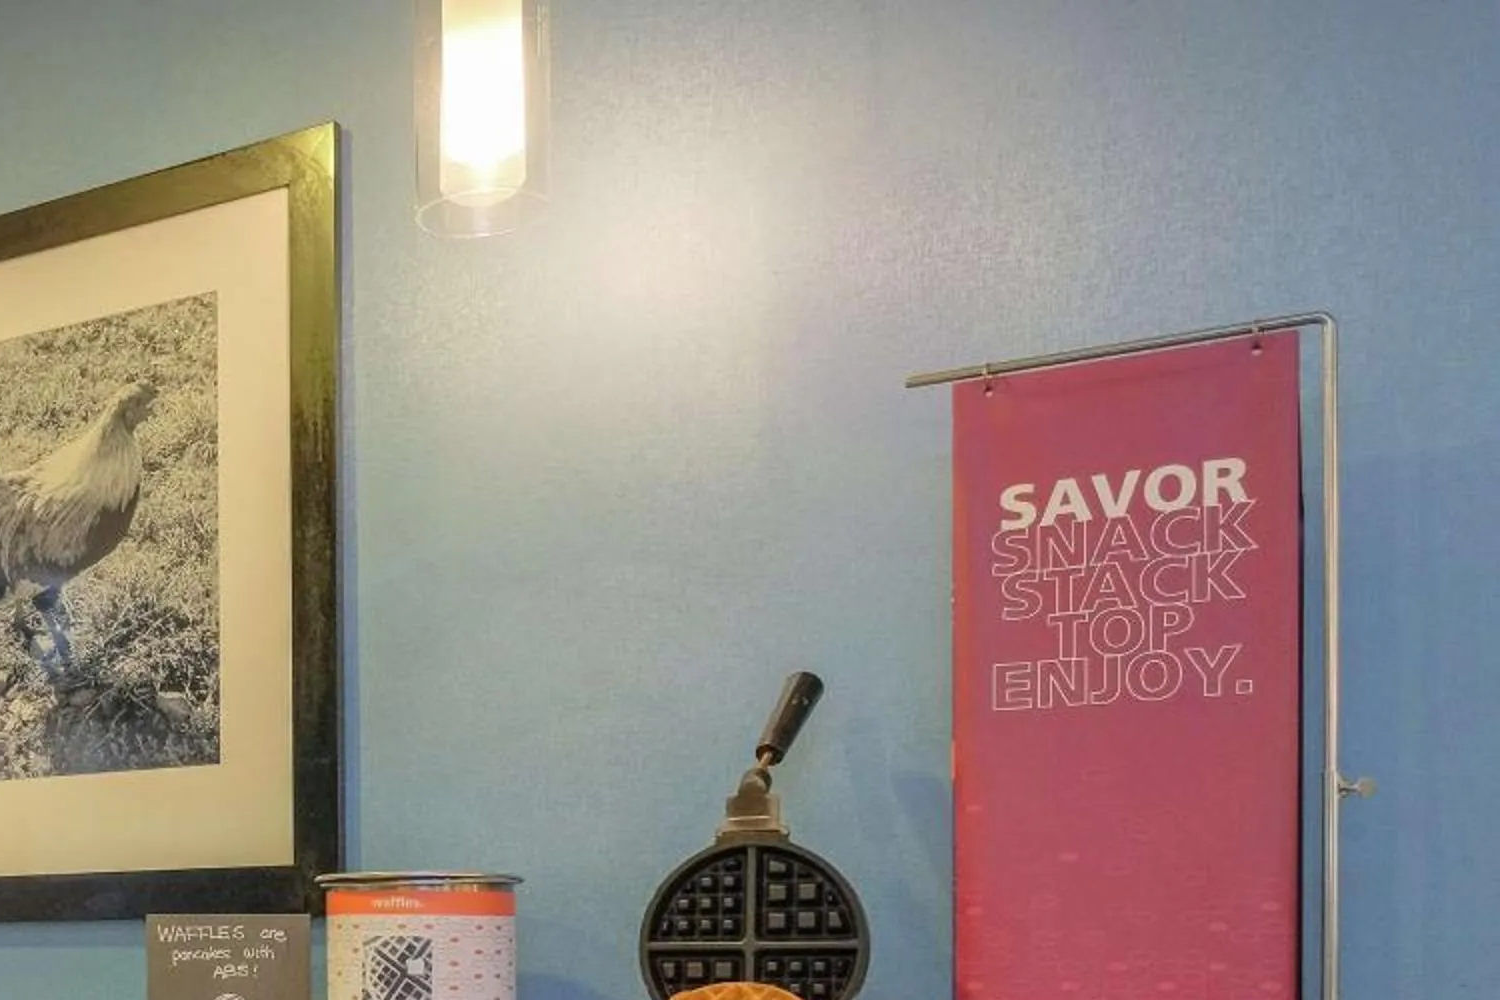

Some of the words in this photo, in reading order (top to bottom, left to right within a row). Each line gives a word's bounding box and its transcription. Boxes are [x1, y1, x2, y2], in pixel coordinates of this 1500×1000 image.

[1000, 457, 1246, 531] SAVOR
[991, 499, 1258, 577] SNACK
[1001, 548, 1247, 621] STACK
[1047, 601, 1195, 661] TOP
[992, 643, 1253, 711] ENJOY.
[157, 923, 245, 943] WAFFLES
[260, 927, 287, 943] are
[172, 945, 231, 967] pancakes
[243, 943, 275, 960] with
